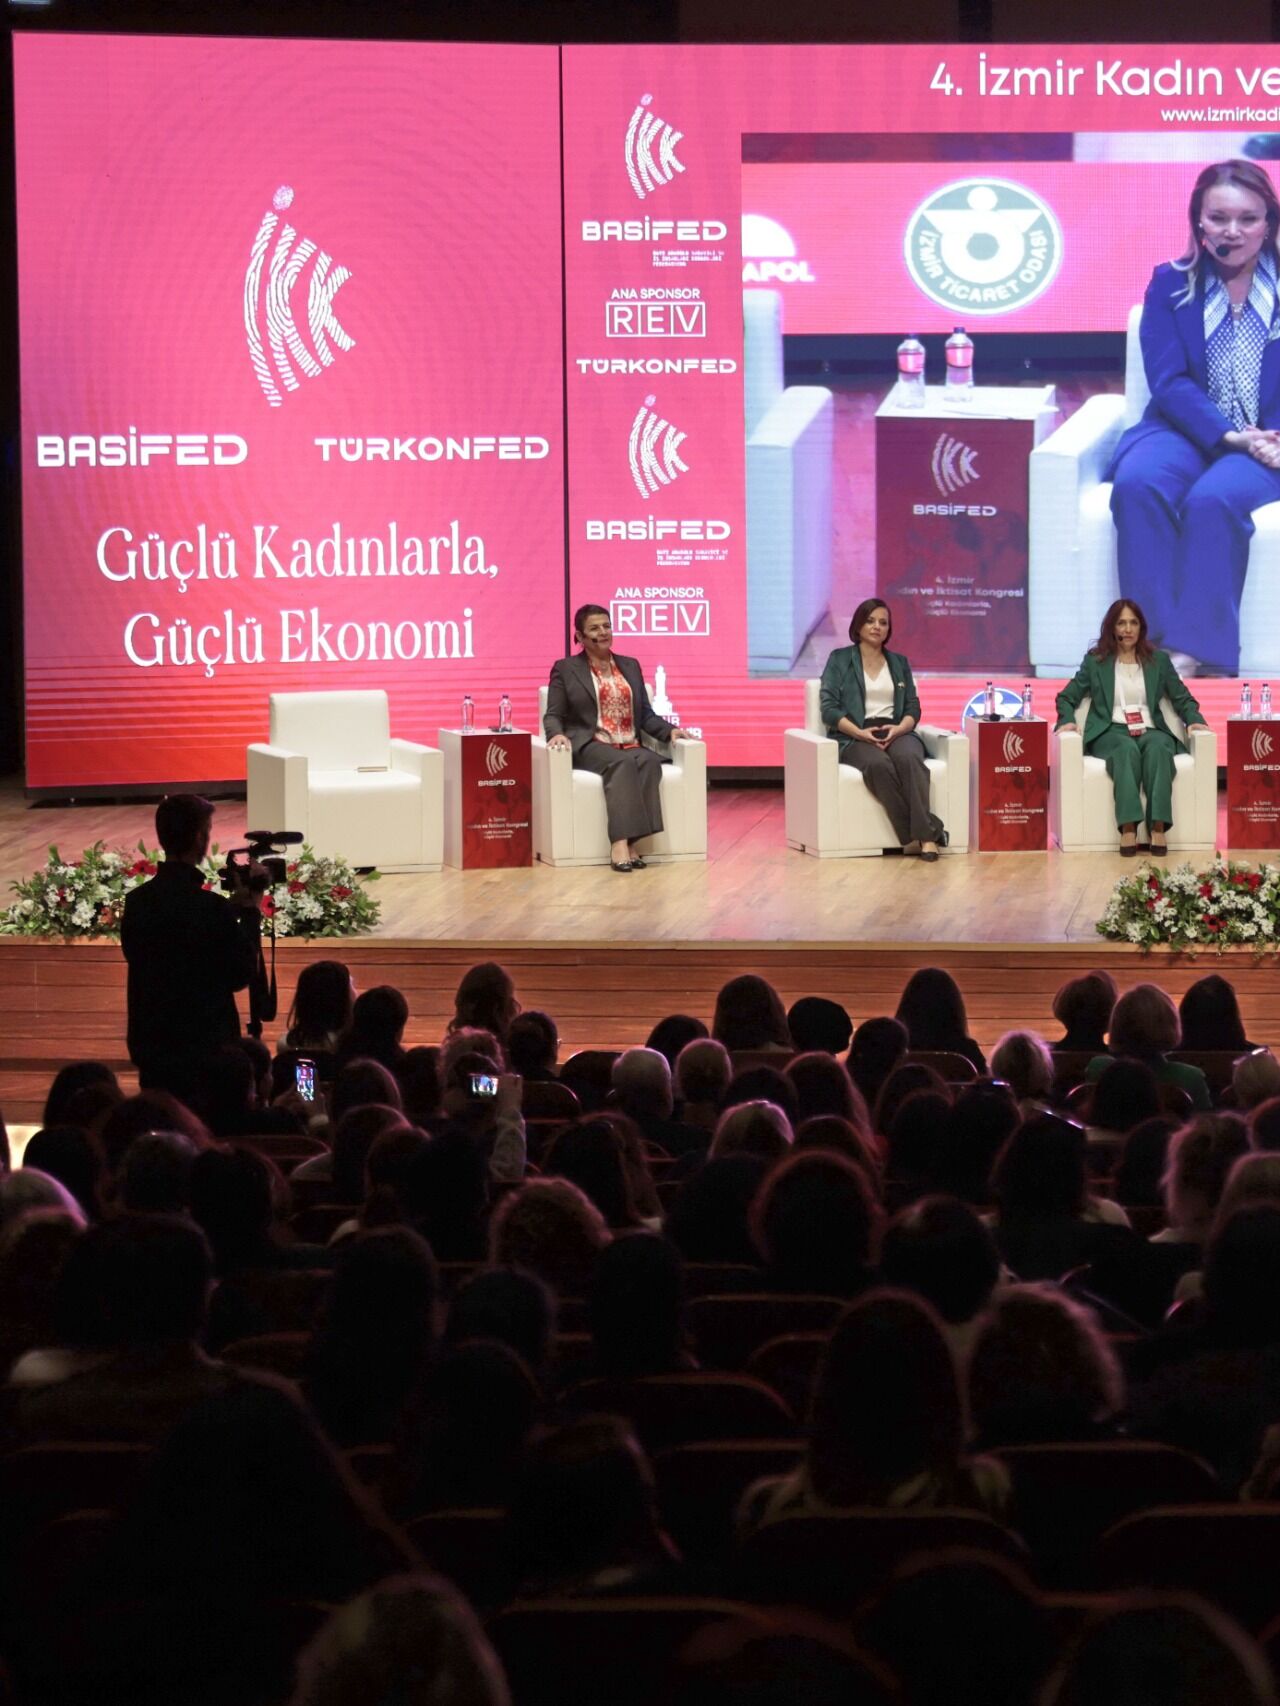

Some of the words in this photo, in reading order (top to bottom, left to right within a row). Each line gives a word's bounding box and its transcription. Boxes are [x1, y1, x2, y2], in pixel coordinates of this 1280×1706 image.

[929, 62, 963, 96] 4.
[979, 52, 1085, 96] İzmir
[1096, 59, 1223, 96] Kadın
[581, 215, 728, 242] BASİFED
[918, 229, 944, 280] İZMİR
[939, 275, 1020, 304] TİCARET
[1019, 229, 1048, 284] ODASI
[610, 288, 638, 300] ANA
[640, 287, 701, 300] SPONSOR
[613, 305, 701, 334] REV
[575, 358, 737, 375] TÜRKONFED
[37, 425, 249, 467] BASİFED
[313, 436, 550, 462] TÜRKONFED
[912, 502, 997, 517] BASİFED
[586, 514, 731, 541] BASİFED
[96, 523, 239, 594] Güçlü
[253, 519, 499, 579] Kadınlarla,
[614, 587, 642, 599] ANA
[644, 587, 704, 599] SPONSOR
[617, 604, 704, 632] REV
[124, 608, 266, 678] Güçlü
[279, 606, 475, 663] Ekonomi
